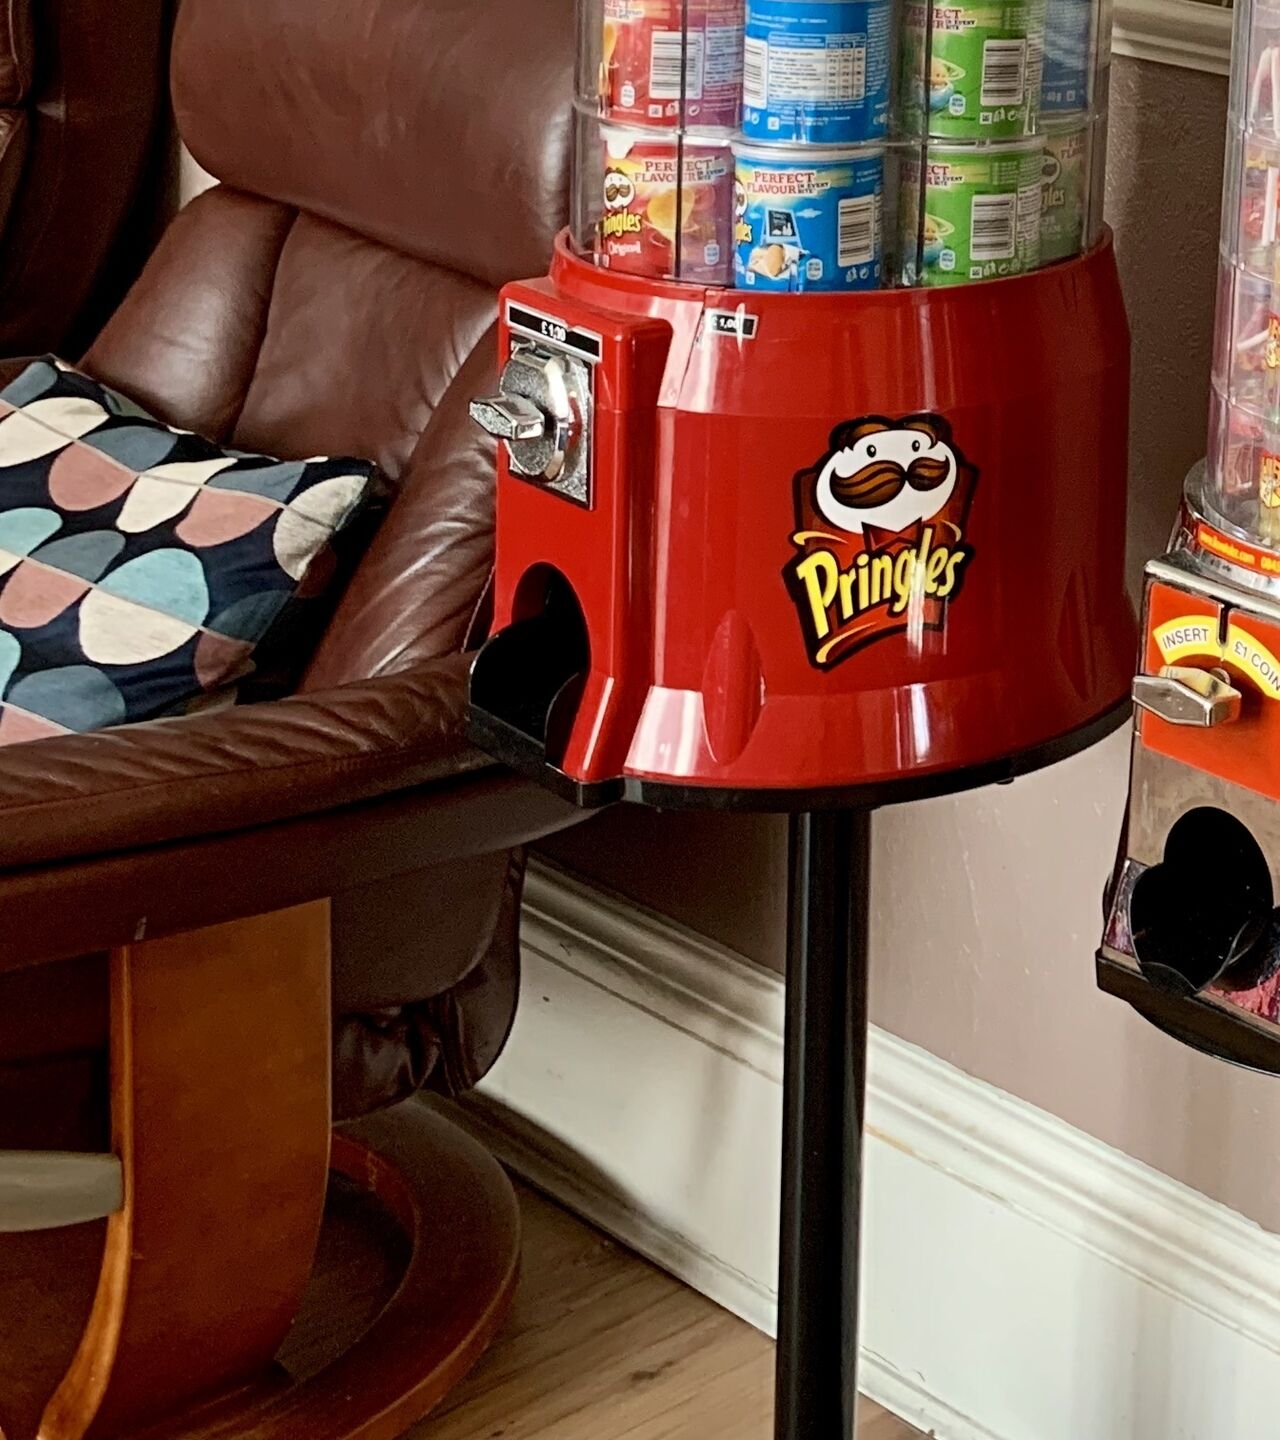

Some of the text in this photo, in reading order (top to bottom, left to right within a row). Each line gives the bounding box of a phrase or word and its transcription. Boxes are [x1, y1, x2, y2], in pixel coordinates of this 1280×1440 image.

[754, 171, 815, 184] PERFECT
[747, 183, 797, 194] FLAVOUR
[796, 527, 965, 640] Pringles
[1162, 628, 1209, 649] INSERT
[1235, 640, 1249, 658] £1
